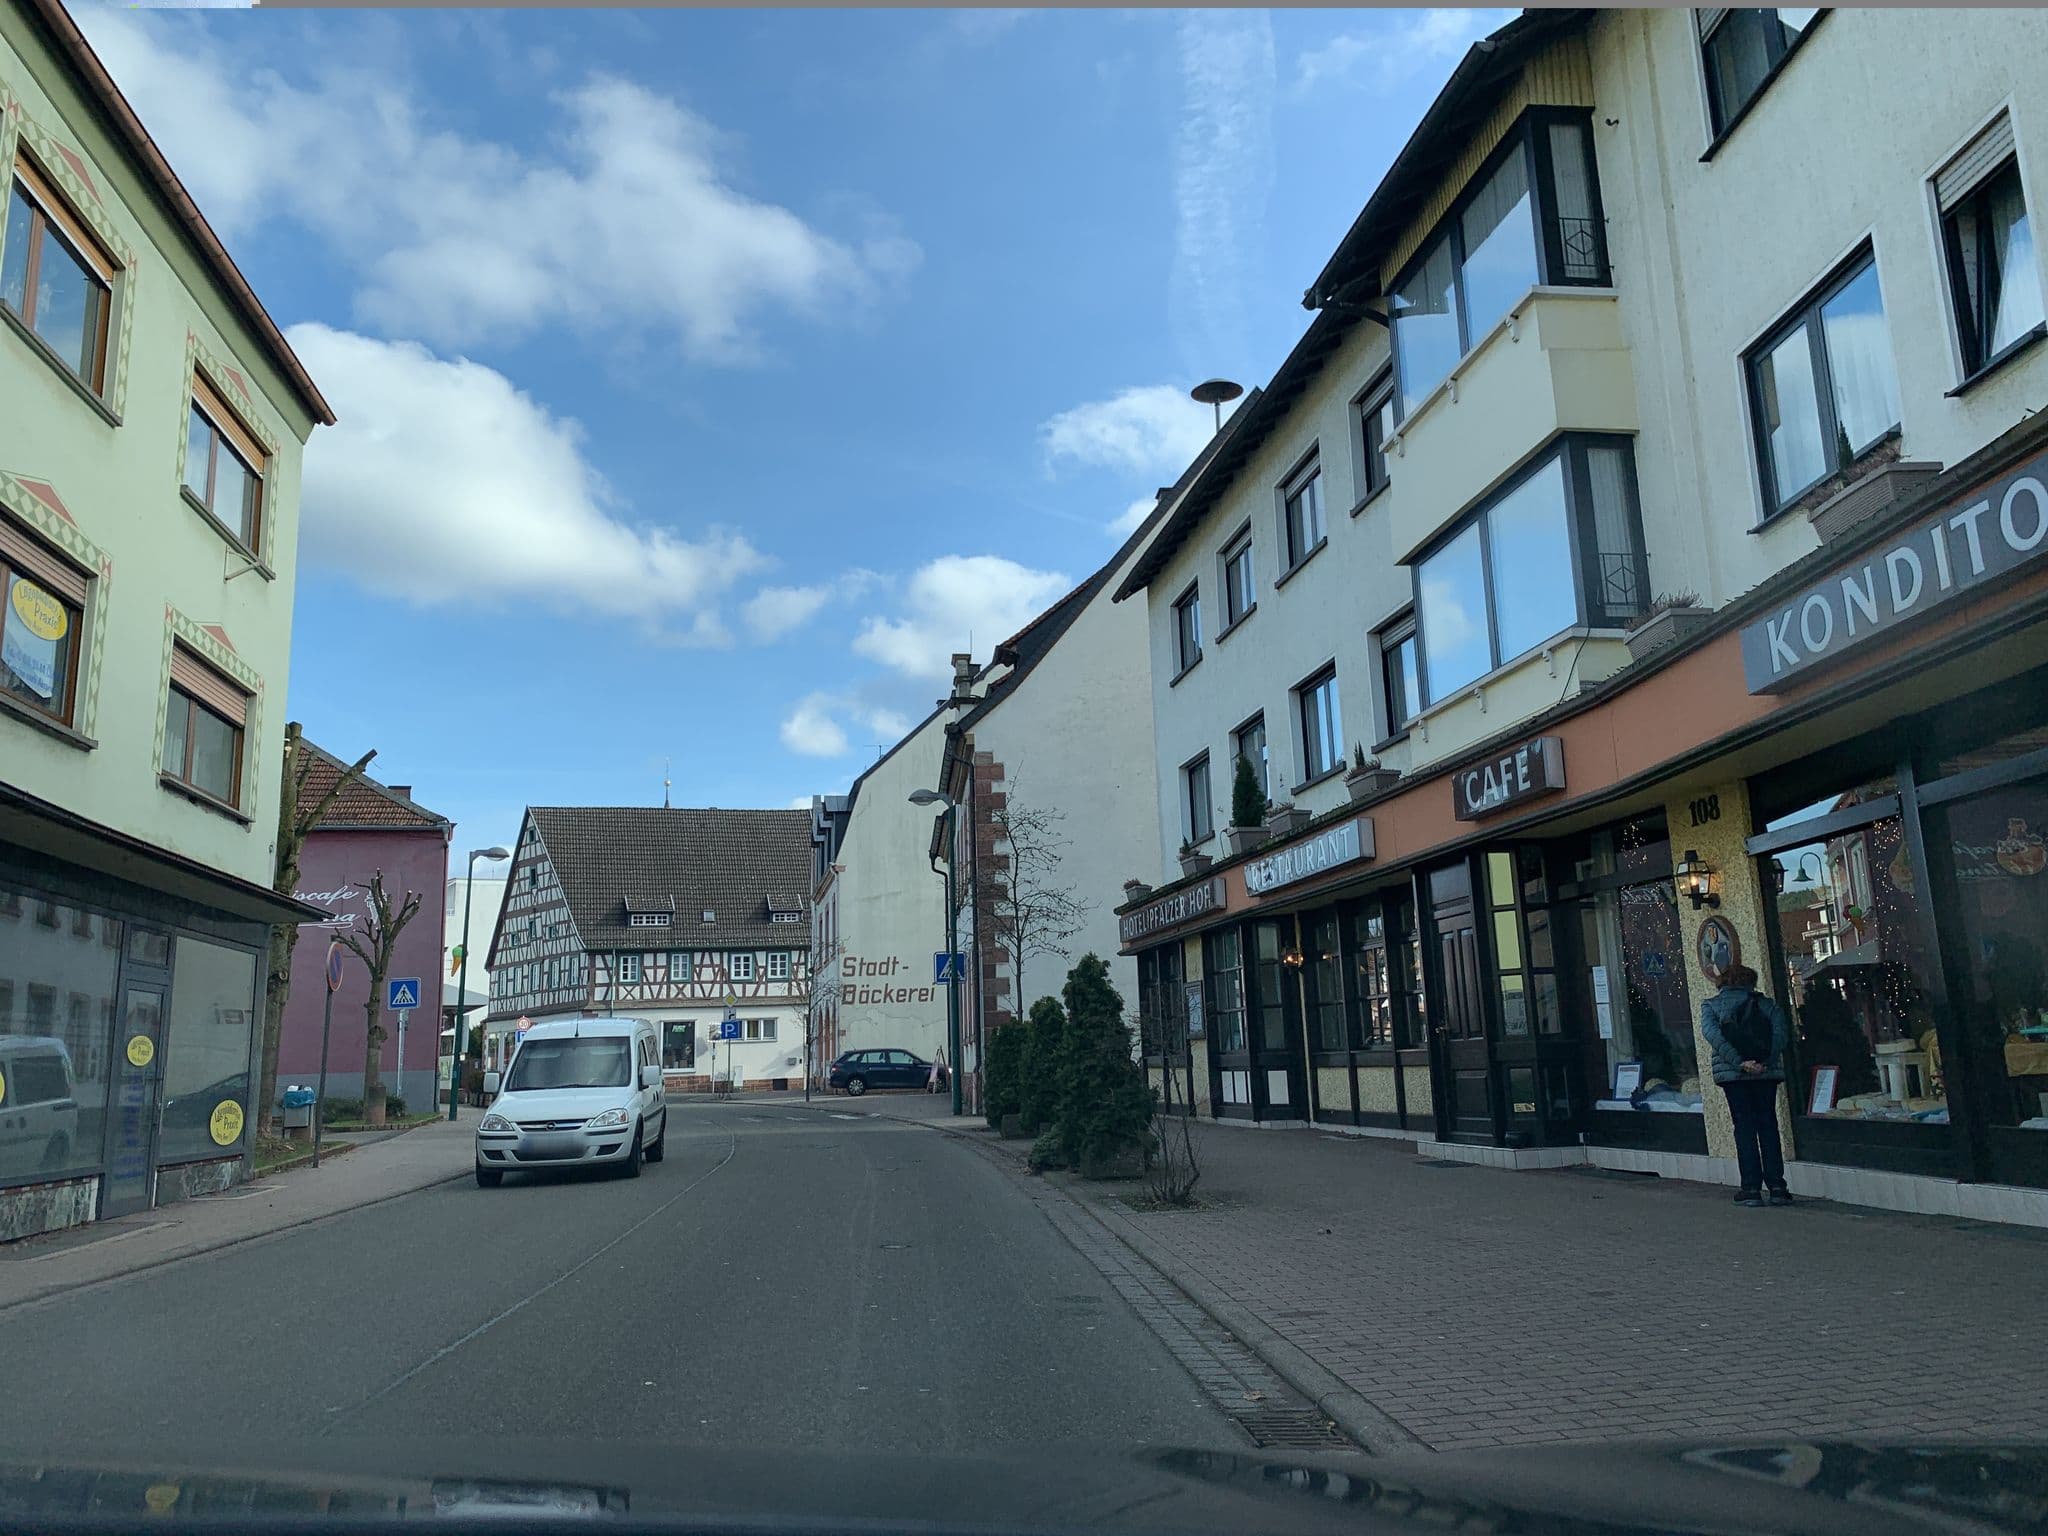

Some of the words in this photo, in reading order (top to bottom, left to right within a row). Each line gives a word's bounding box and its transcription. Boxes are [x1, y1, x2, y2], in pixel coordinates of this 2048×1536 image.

[1766, 476, 2048, 674] KONDITO
[1688, 794, 1721, 827] 108
[1250, 826, 1350, 892] RESTAURANT
[291, 885, 359, 905] iscafe
[841, 982, 935, 1005] Bäckerei
[724, 1023, 735, 1038] P
